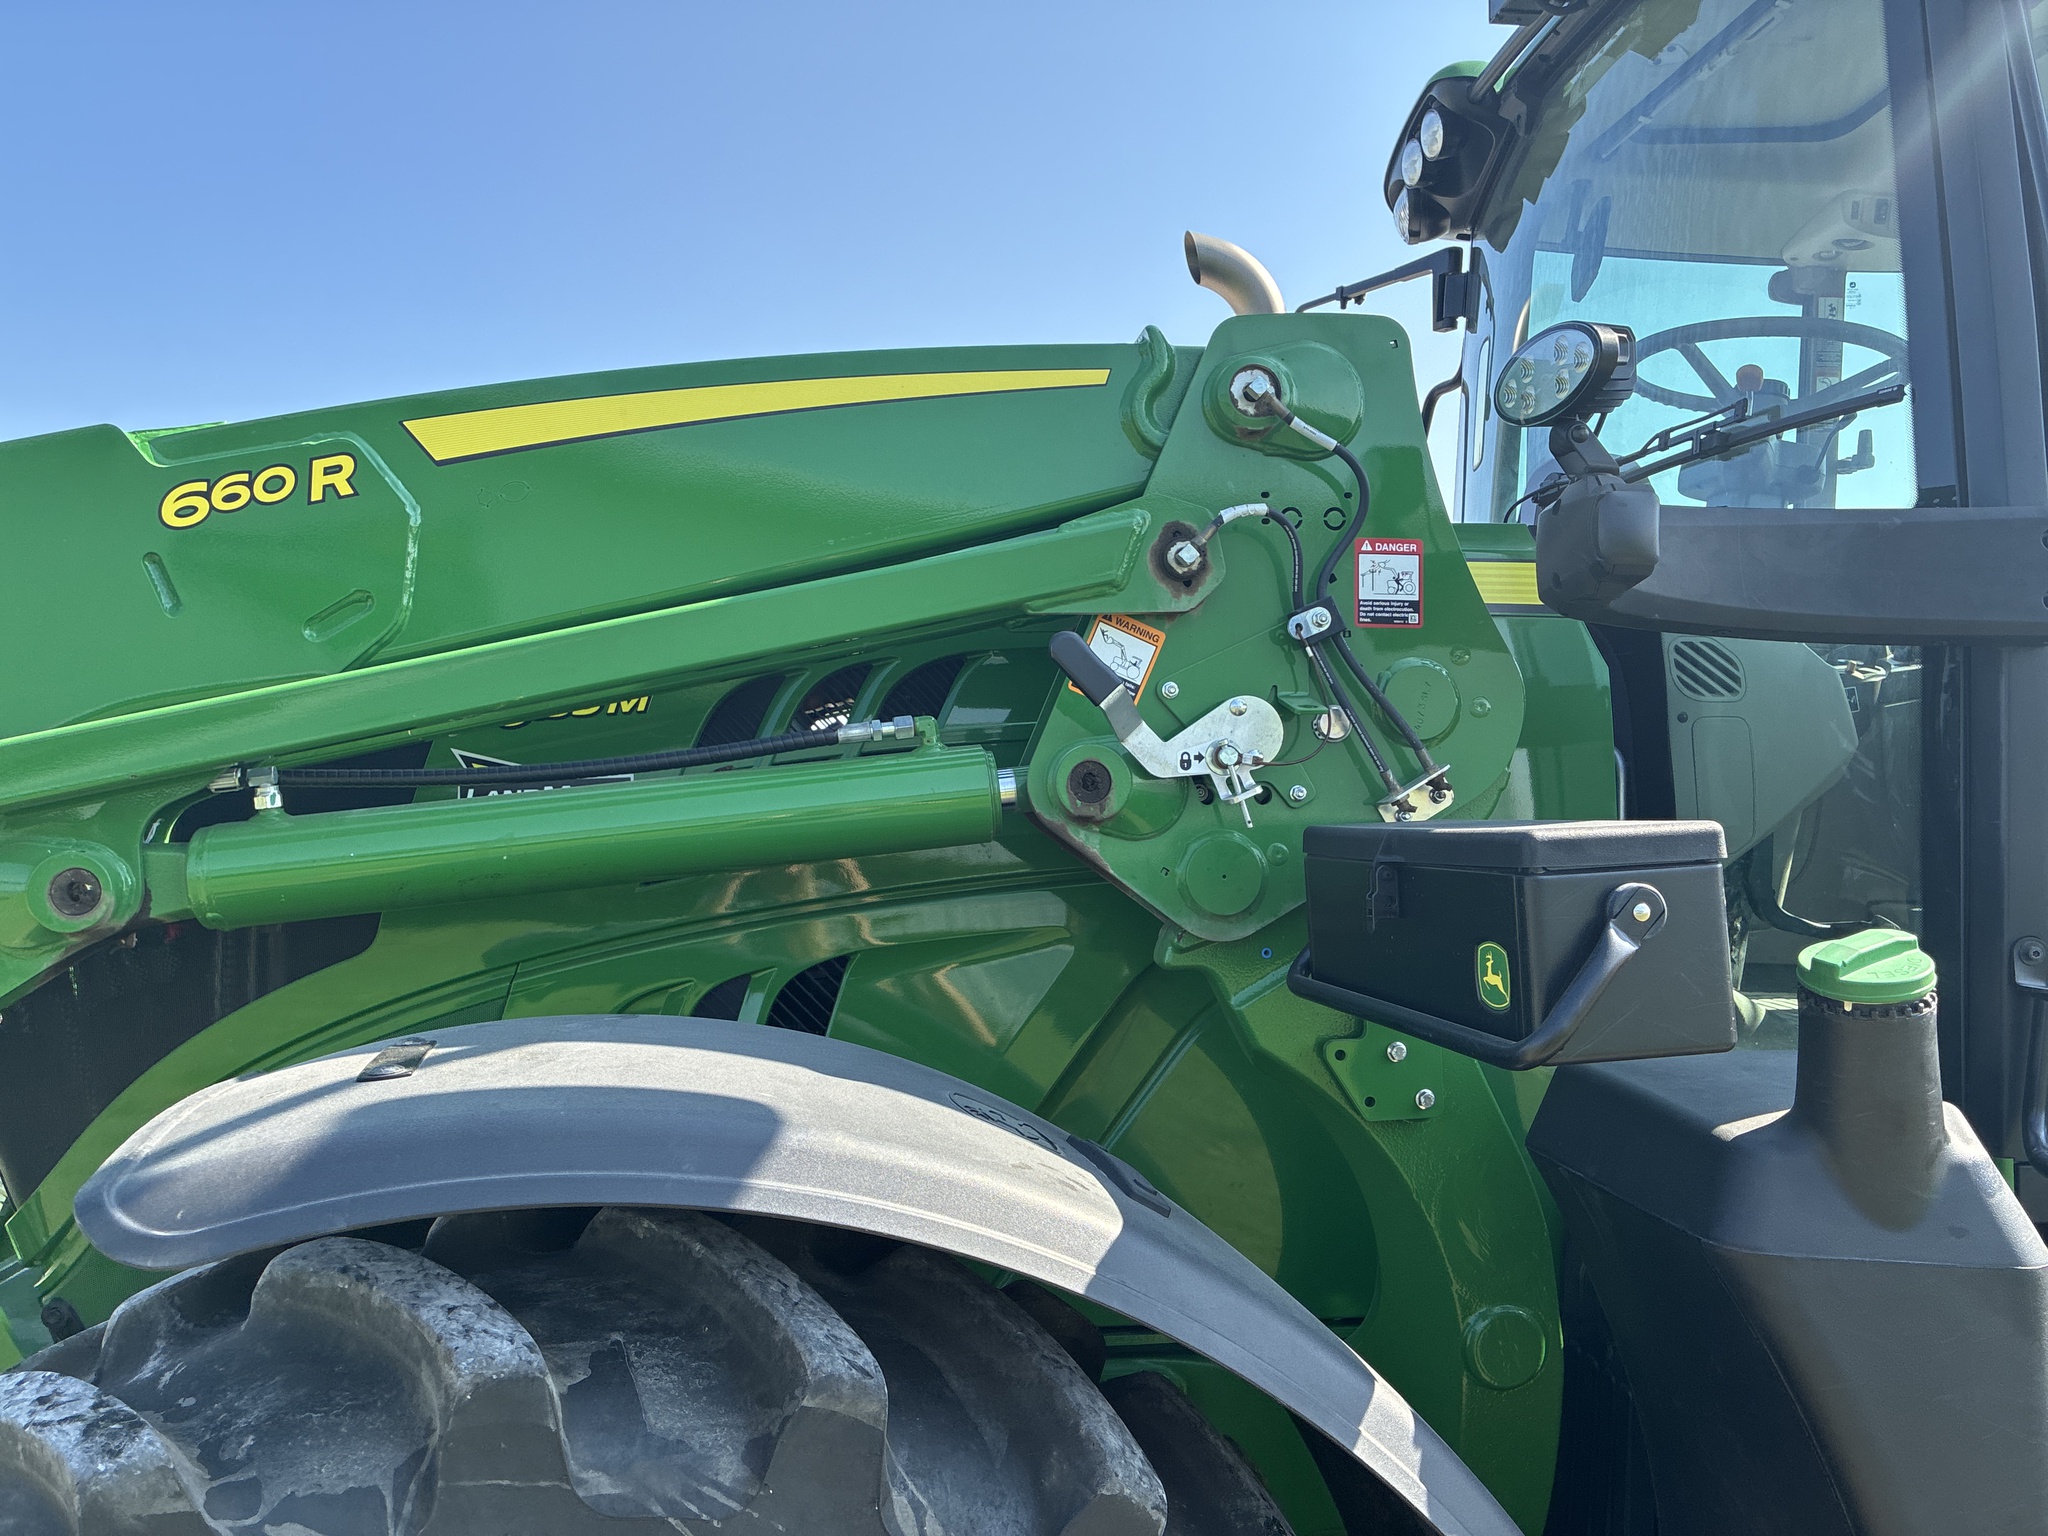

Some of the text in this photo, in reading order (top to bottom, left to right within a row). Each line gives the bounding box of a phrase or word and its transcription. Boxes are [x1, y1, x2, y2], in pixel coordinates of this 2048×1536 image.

[158, 452, 358, 530] 660 R
[1375, 543, 1417, 552] DANGER
[1115, 617, 1160, 643] WARNING
[1866, 957, 1923, 979] DIESEL
